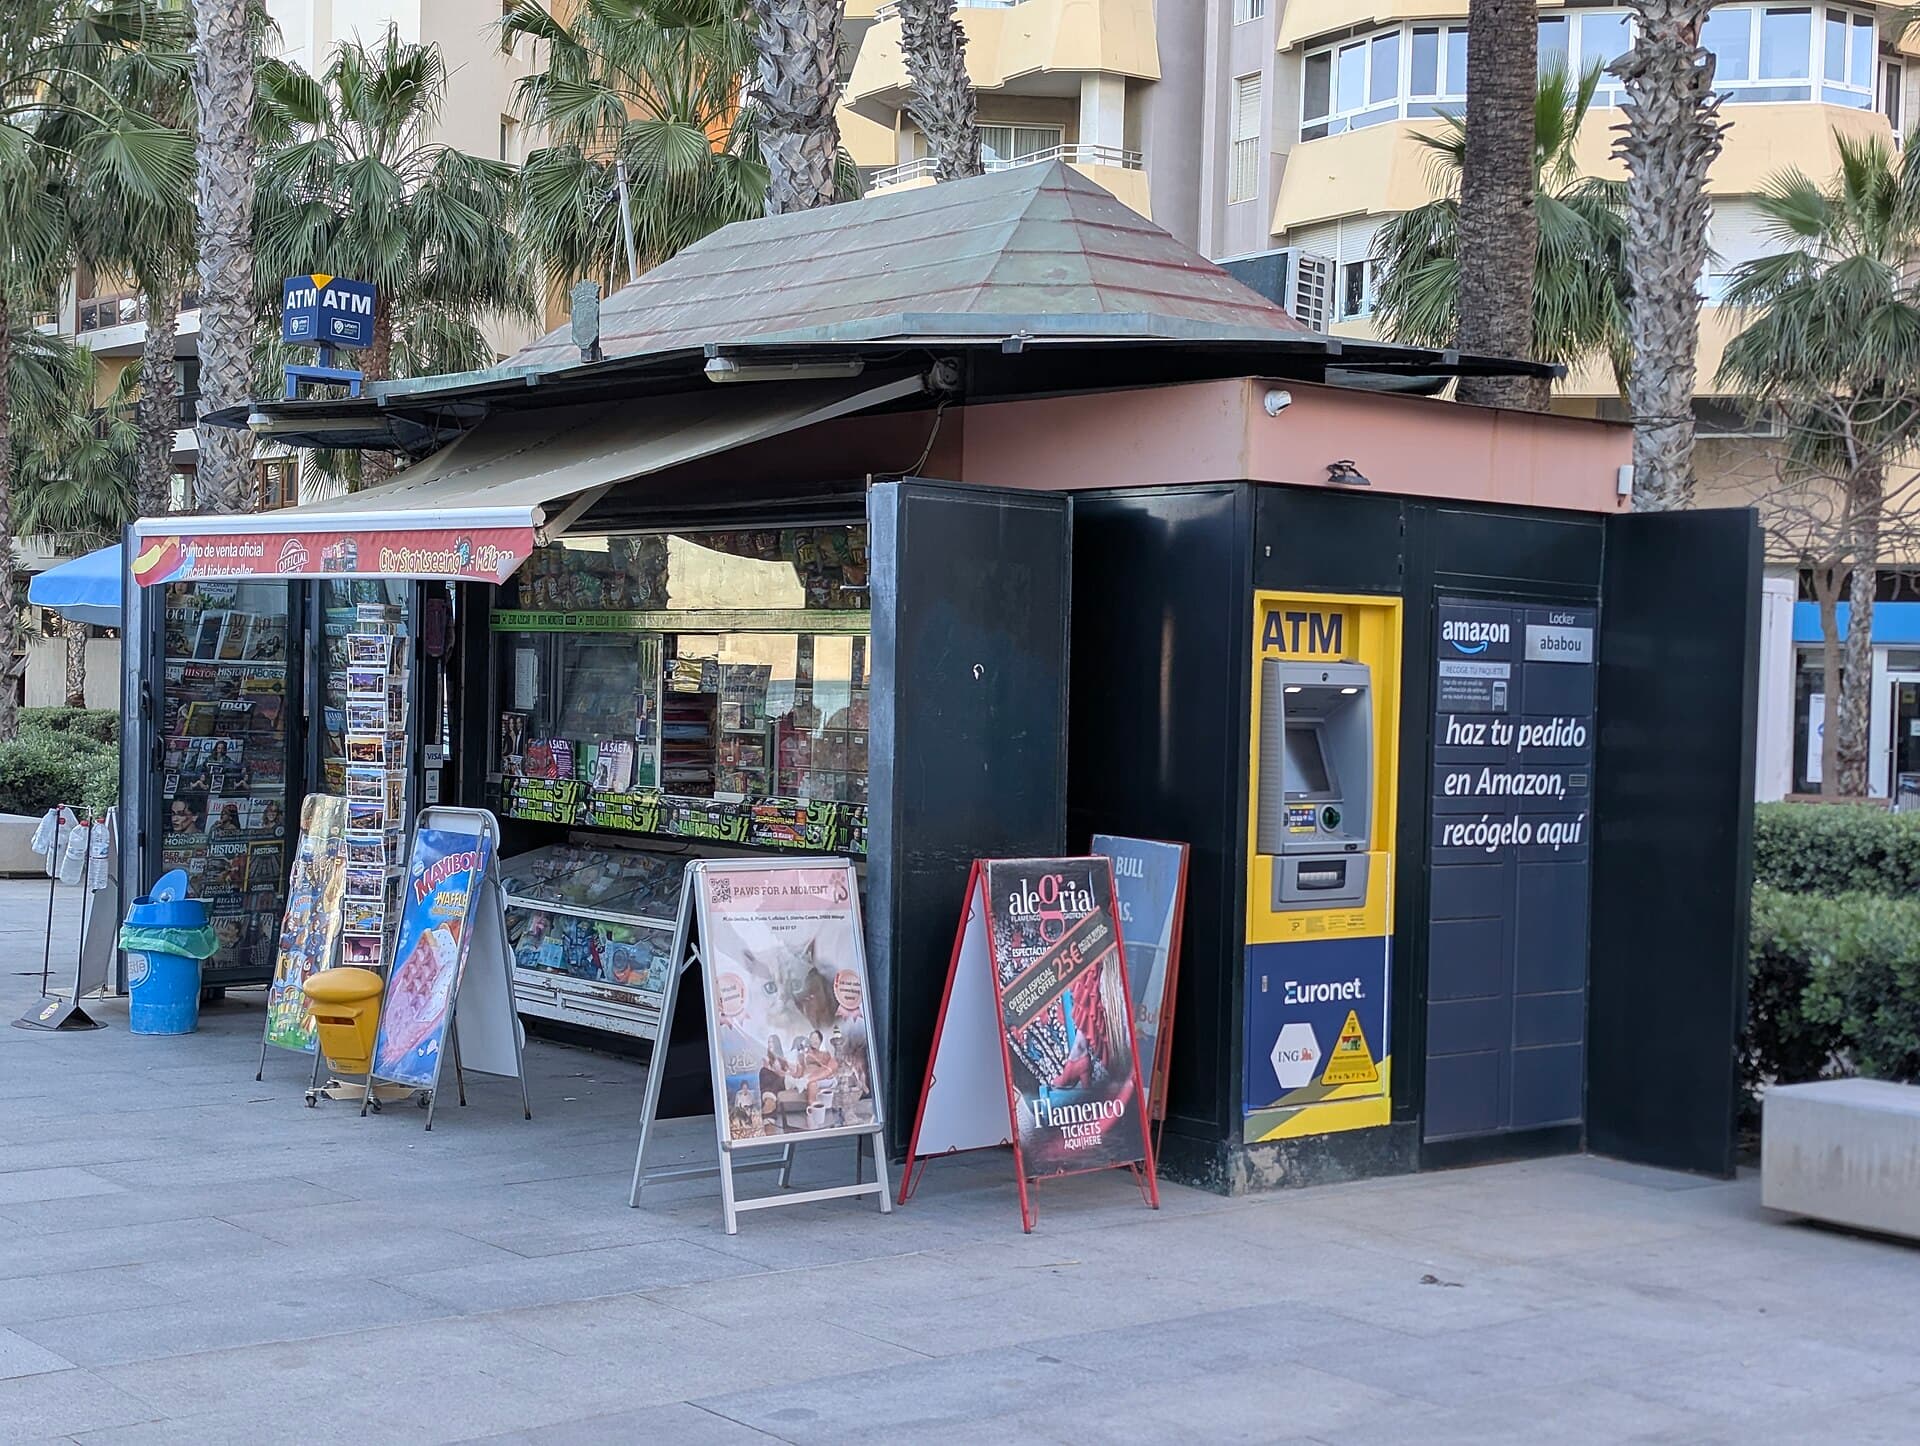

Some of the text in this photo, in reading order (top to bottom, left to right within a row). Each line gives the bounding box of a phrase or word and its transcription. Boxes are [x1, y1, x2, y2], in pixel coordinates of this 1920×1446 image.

[286, 288, 316, 310] ATM
[322, 289, 371, 315] ATM
[181, 542, 264, 557] Punto de venta oficial
[179, 563, 254, 577] Official ticket seller
[279, 552, 307, 572] OFFICIAL
[1549, 612, 1575, 625] Locker
[1262, 611, 1343, 654] ATM
[1442, 620, 1510, 643] amazon
[1540, 635, 1582, 651] ababou
[184, 667, 217, 679] HISTOR
[1446, 665, 1504, 676] RECOGE TU PAQUETE
[221, 702, 253, 711] muy
[1445, 715, 1586, 753] haz tu pedido
[600, 741, 631, 753] LA SAETA
[1444, 767, 1566, 800] en Amazon,
[1442, 813, 1585, 852] recógelo aquí
[210, 844, 248, 855] HISTORIA
[1116, 855, 1144, 878] BULL
[414, 851, 483, 906] MAXIBON
[734, 885, 828, 896] PAWS FOR A MOMENT
[1052, 941, 1083, 980] 25€
[1009, 967, 1054, 1010] OFERTA ESPECIAL
[1016, 974, 1057, 1016] SPECIAL OFFER
[1284, 978, 1361, 1005] Euronet
[1278, 1050, 1299, 1063] ING
[1032, 1097, 1124, 1128] Flamenco
[1061, 1121, 1101, 1139] TICKETS
[1084, 1135, 1102, 1146] HERE
